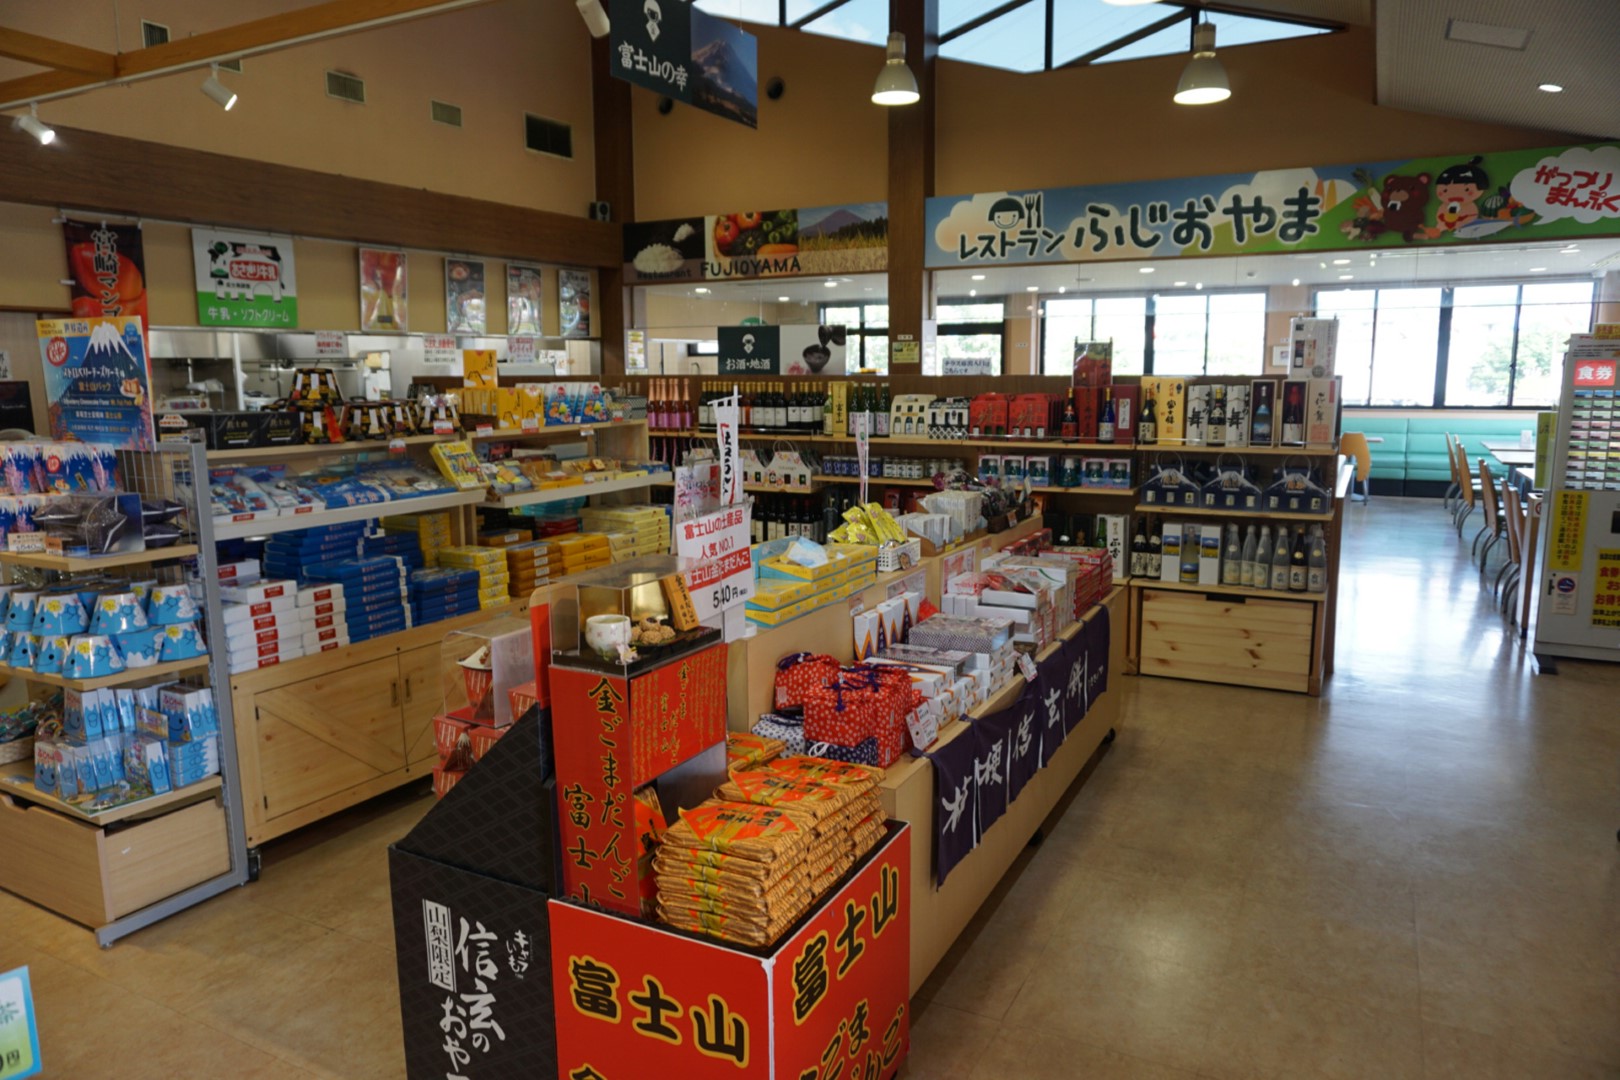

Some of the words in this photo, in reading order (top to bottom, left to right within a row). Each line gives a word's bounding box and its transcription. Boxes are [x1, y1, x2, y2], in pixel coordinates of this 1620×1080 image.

[618, 40, 688, 91] 富士山の幸
[1534, 165, 1613, 190] がっつり
[1545, 186, 1620, 212] まんぷく
[1073, 187, 1321, 252] ふじおやま
[958, 229, 1066, 260] レストラン
[231, 263, 277, 279] あさぎり牛乳
[637, 269, 692, 281] Restaurant
[700, 257, 801, 276] FUJIOYAMA
[208, 306, 289, 322] 牛乳・ソフトクリーム
[726, 358, 771, 370] お酒・地酒
[1576, 365, 1613, 380] 食券
[684, 509, 743, 541] 富士山の土産品
[701, 541, 718, 559] 人気
[719, 535, 735, 555] NO.1
[713, 584, 739, 609] 540円
[588, 677, 632, 899] 金ごまだんご
[428, 905, 452, 990] 山梨限定
[793, 863, 899, 1025] 富士山
[455, 916, 505, 1053] 信玄の
[570, 956, 750, 1067] 富士山
[439, 995, 472, 1080] おや
